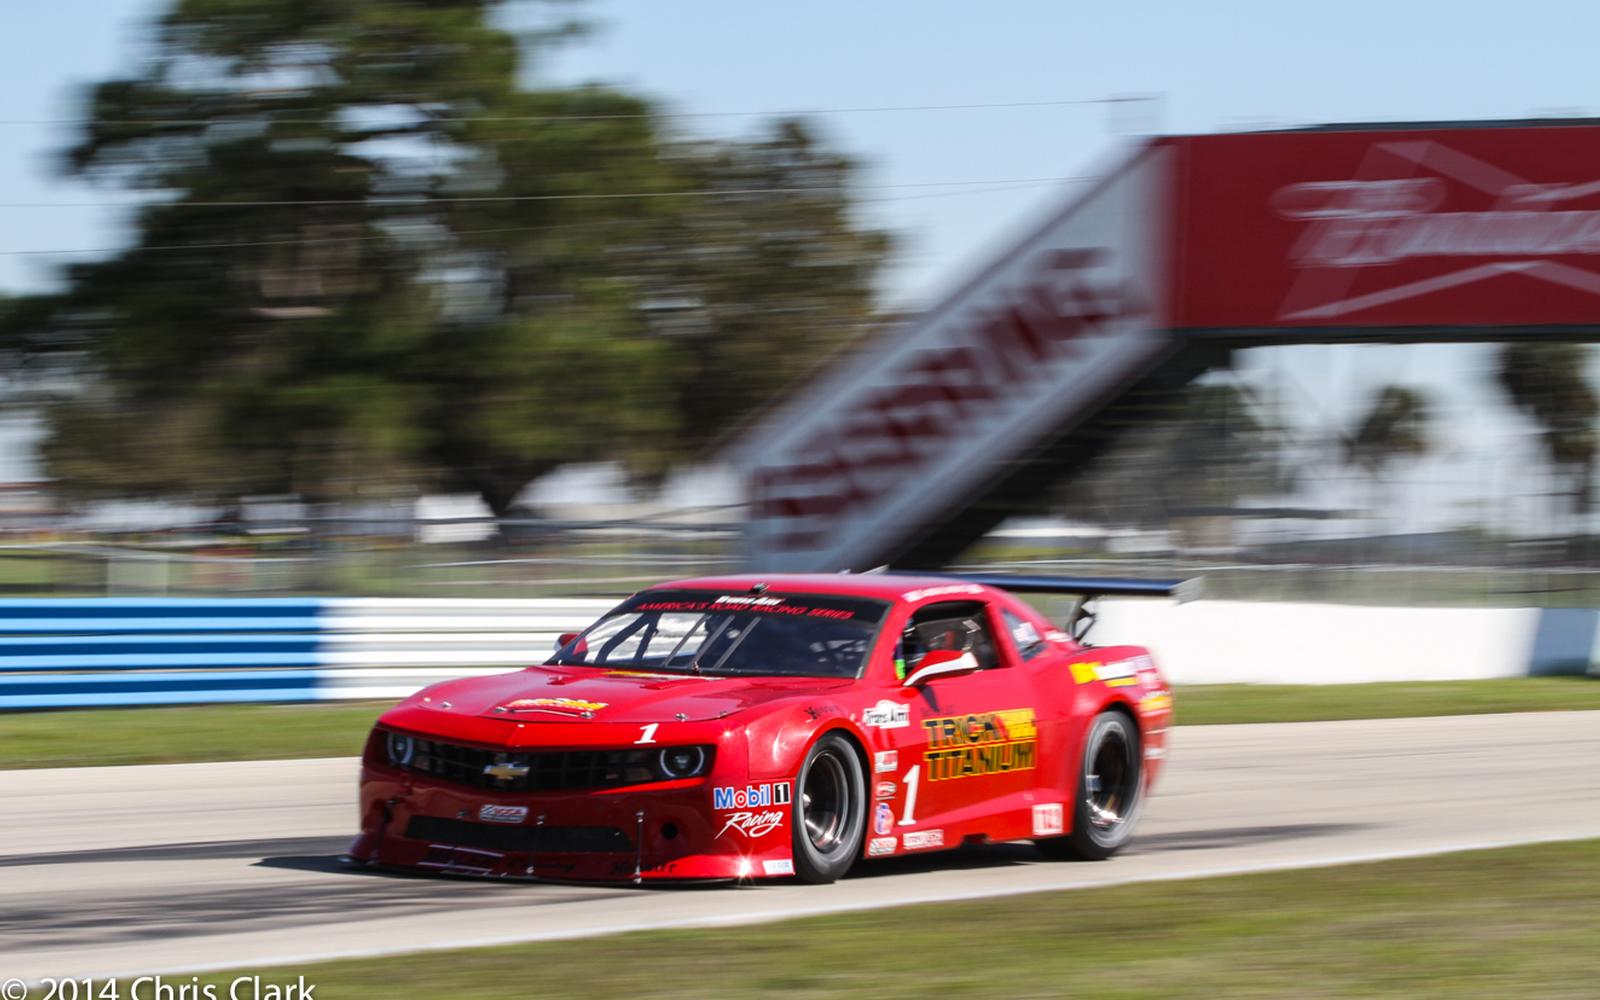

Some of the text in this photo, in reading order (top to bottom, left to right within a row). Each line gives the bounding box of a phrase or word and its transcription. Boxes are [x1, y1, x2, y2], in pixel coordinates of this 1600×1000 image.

[708, 602, 751, 612] ROAD
[751, 604, 807, 615] RACING
[807, 607, 856, 619] SERIES
[633, 722, 659, 744] 1
[922, 740, 1037, 781] TITANIUM
[713, 784, 771, 810] Mobil
[897, 764, 920, 826] 1
[714, 810, 784, 840] Racing
